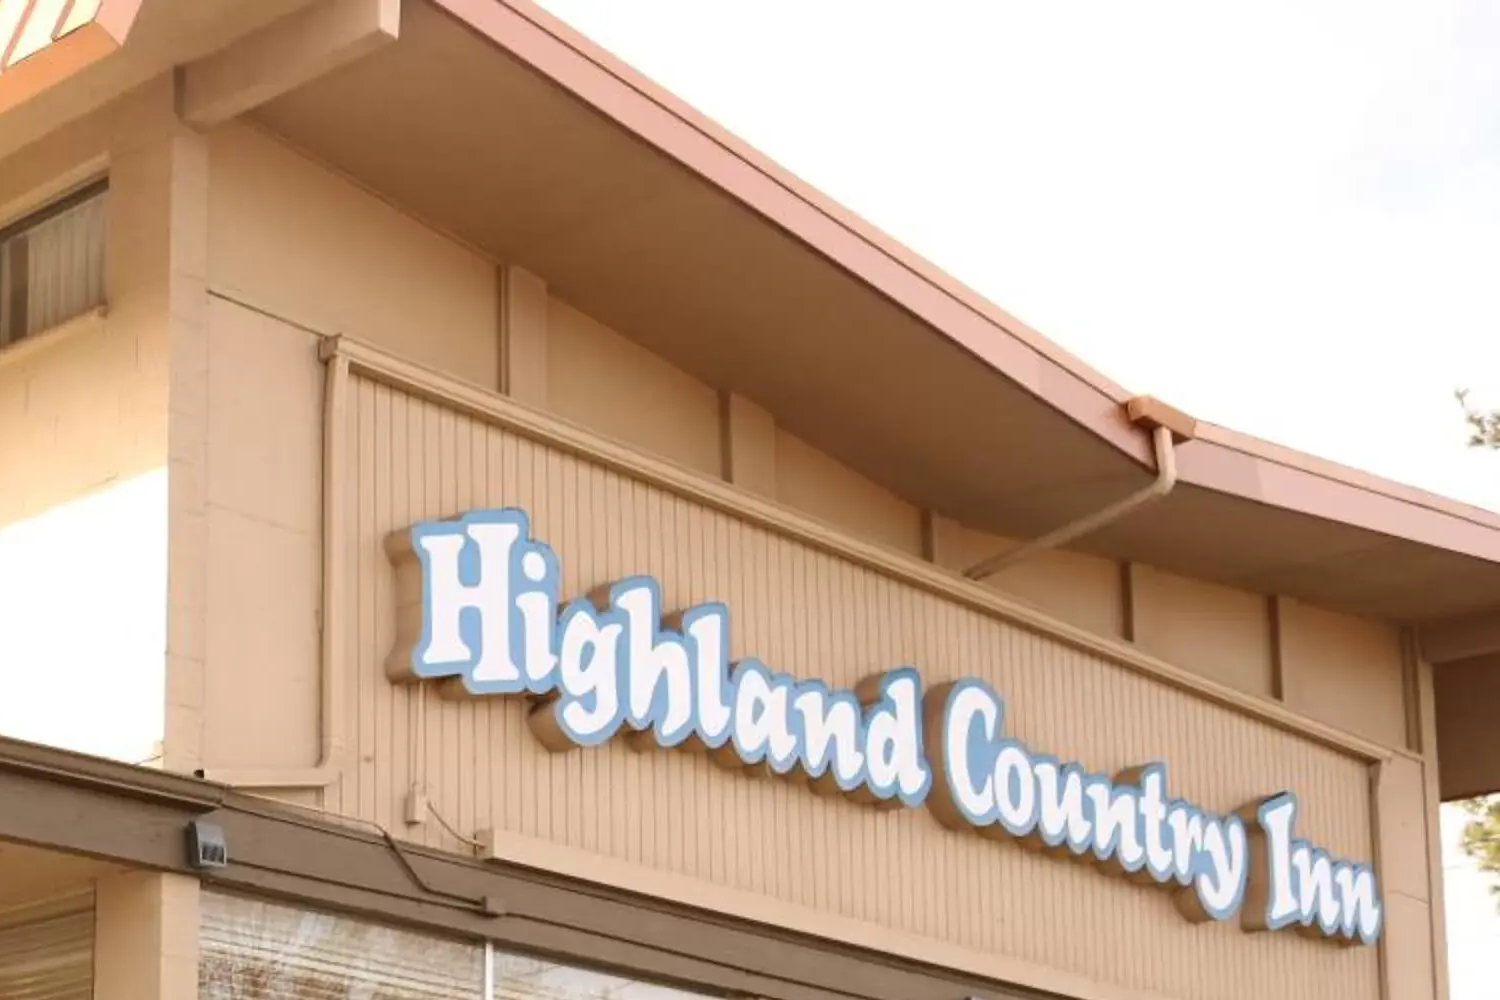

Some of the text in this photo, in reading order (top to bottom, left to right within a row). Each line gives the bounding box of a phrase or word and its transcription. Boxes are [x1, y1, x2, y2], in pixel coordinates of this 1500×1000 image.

[413, 509, 1383, 946] Highland Country Inn
